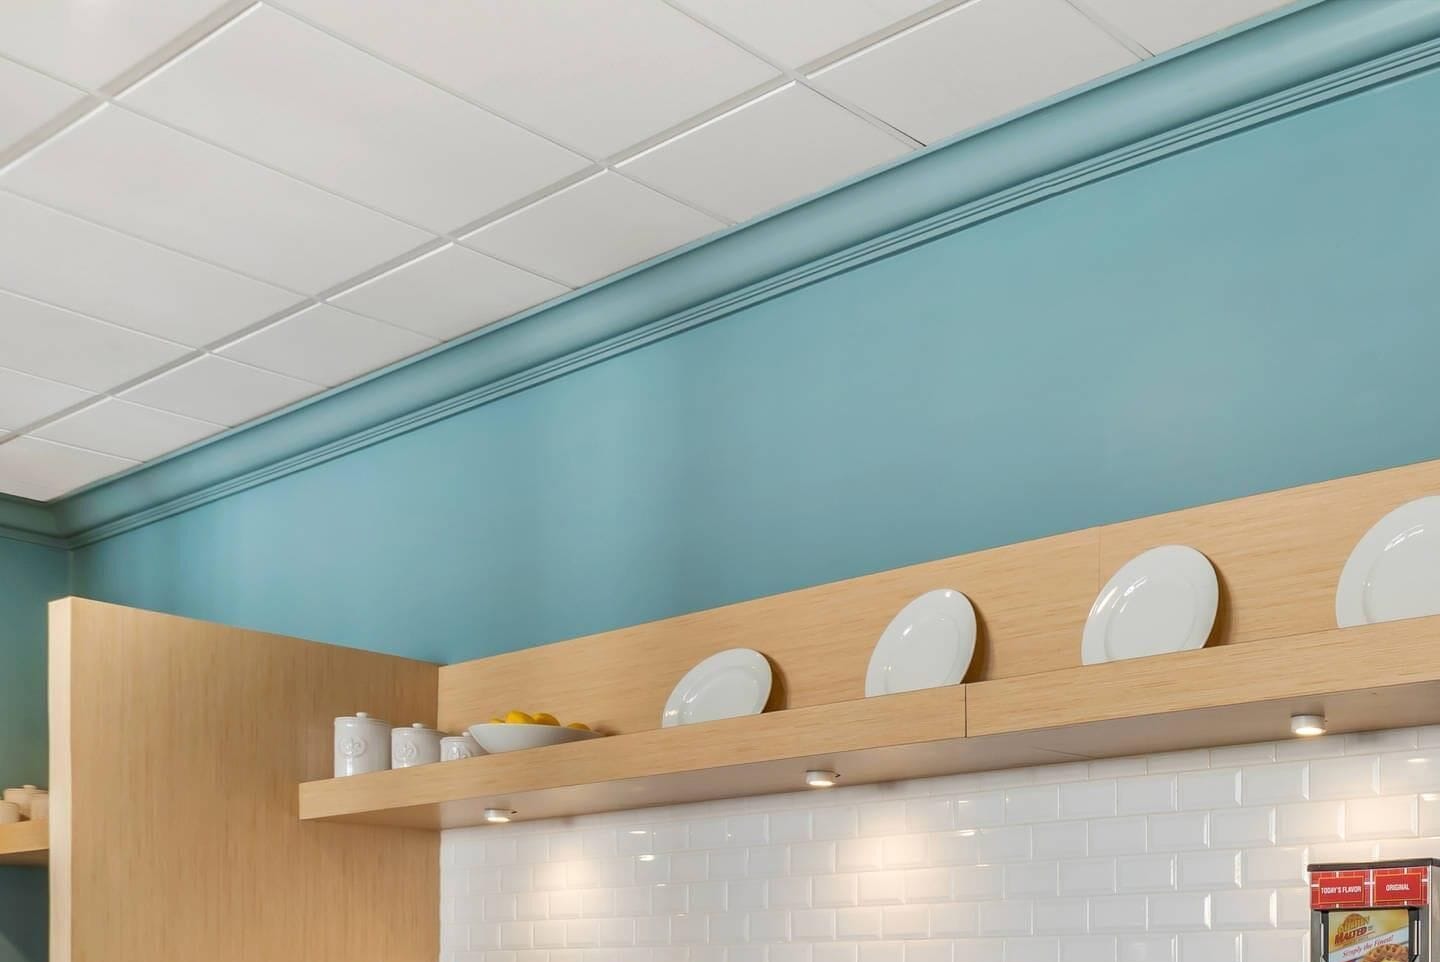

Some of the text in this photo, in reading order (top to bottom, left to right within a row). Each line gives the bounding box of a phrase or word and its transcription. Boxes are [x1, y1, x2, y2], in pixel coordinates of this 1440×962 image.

[1321, 885, 1362, 895] TODAY'S FLAVOR
[1385, 883, 1410, 892] ORIGINAL
